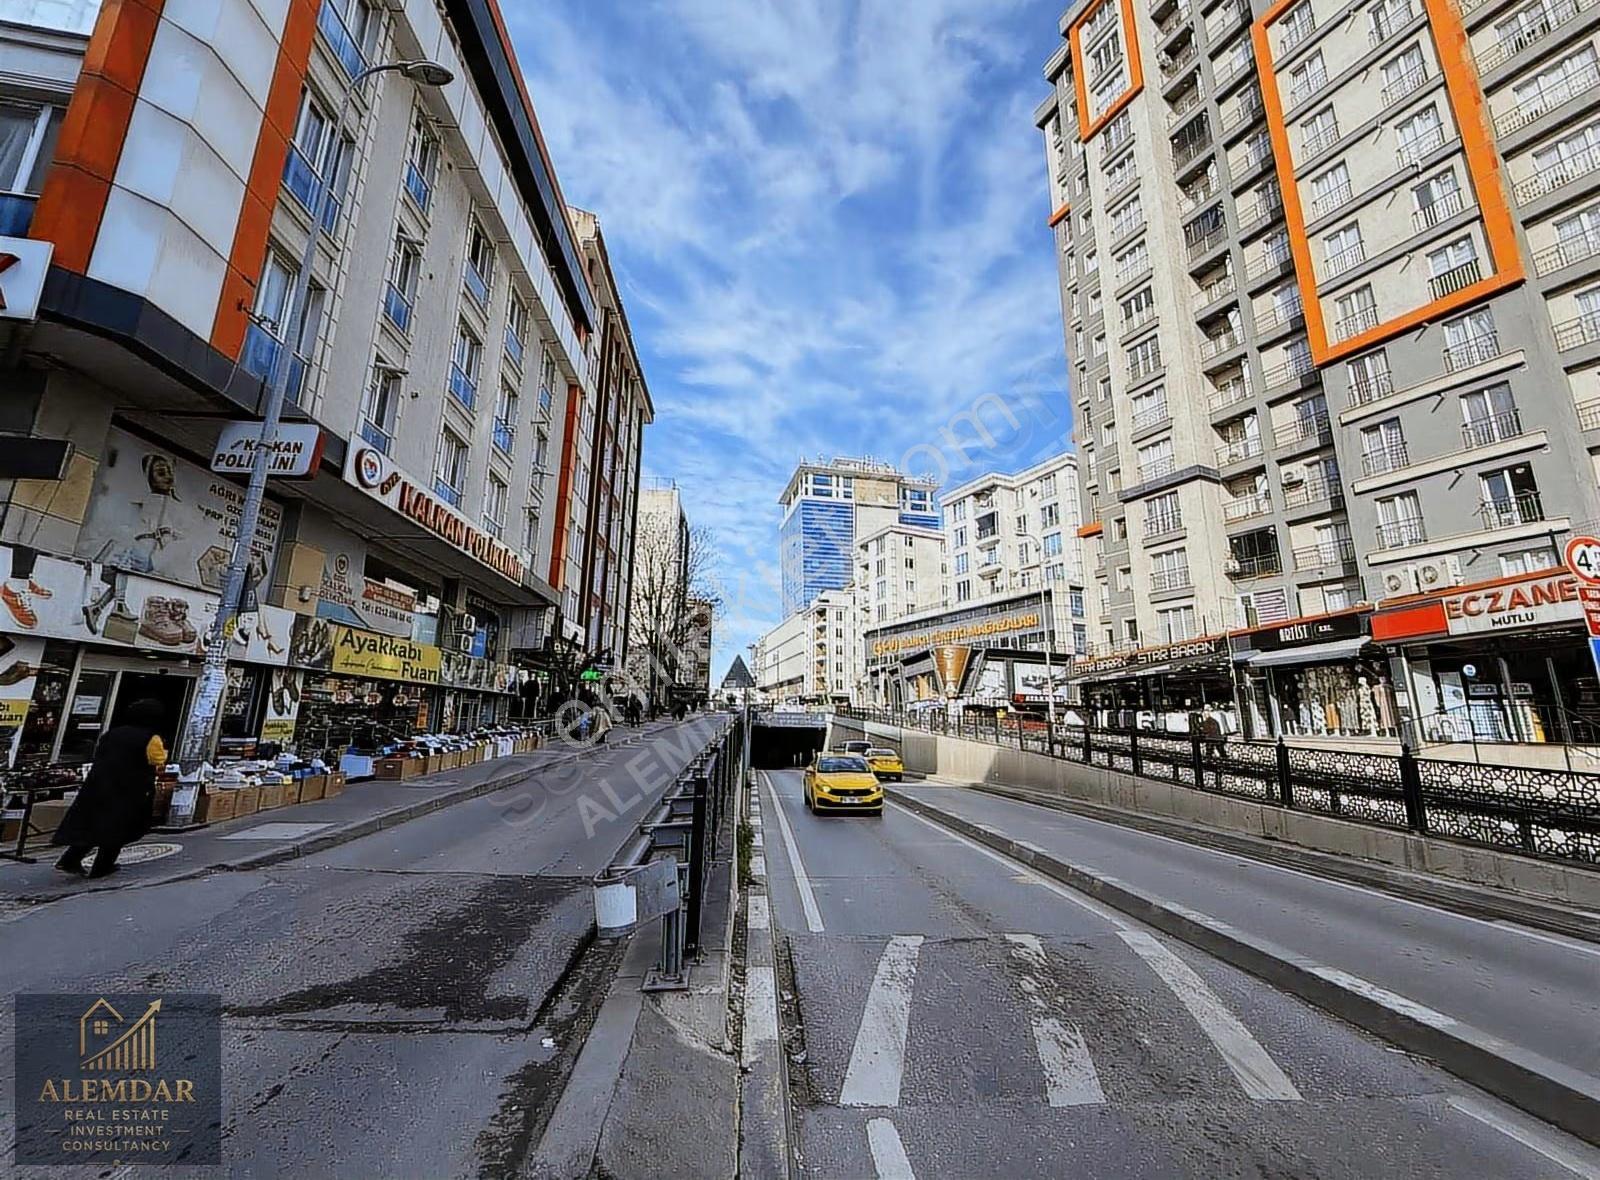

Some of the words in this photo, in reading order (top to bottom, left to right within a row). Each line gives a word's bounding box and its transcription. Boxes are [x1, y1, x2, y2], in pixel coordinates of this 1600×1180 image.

[243, 440, 303, 454] KKAN
[214, 452, 297, 470] POLİİNİ
[398, 481, 466, 548] KALKAN
[1446, 580, 1578, 619] ECZANE
[1491, 612, 1535, 628] MUTLU
[340, 628, 422, 662] Ayakkabı
[1137, 650, 1169, 664] STAR
[1170, 640, 1216, 659] BARAN
